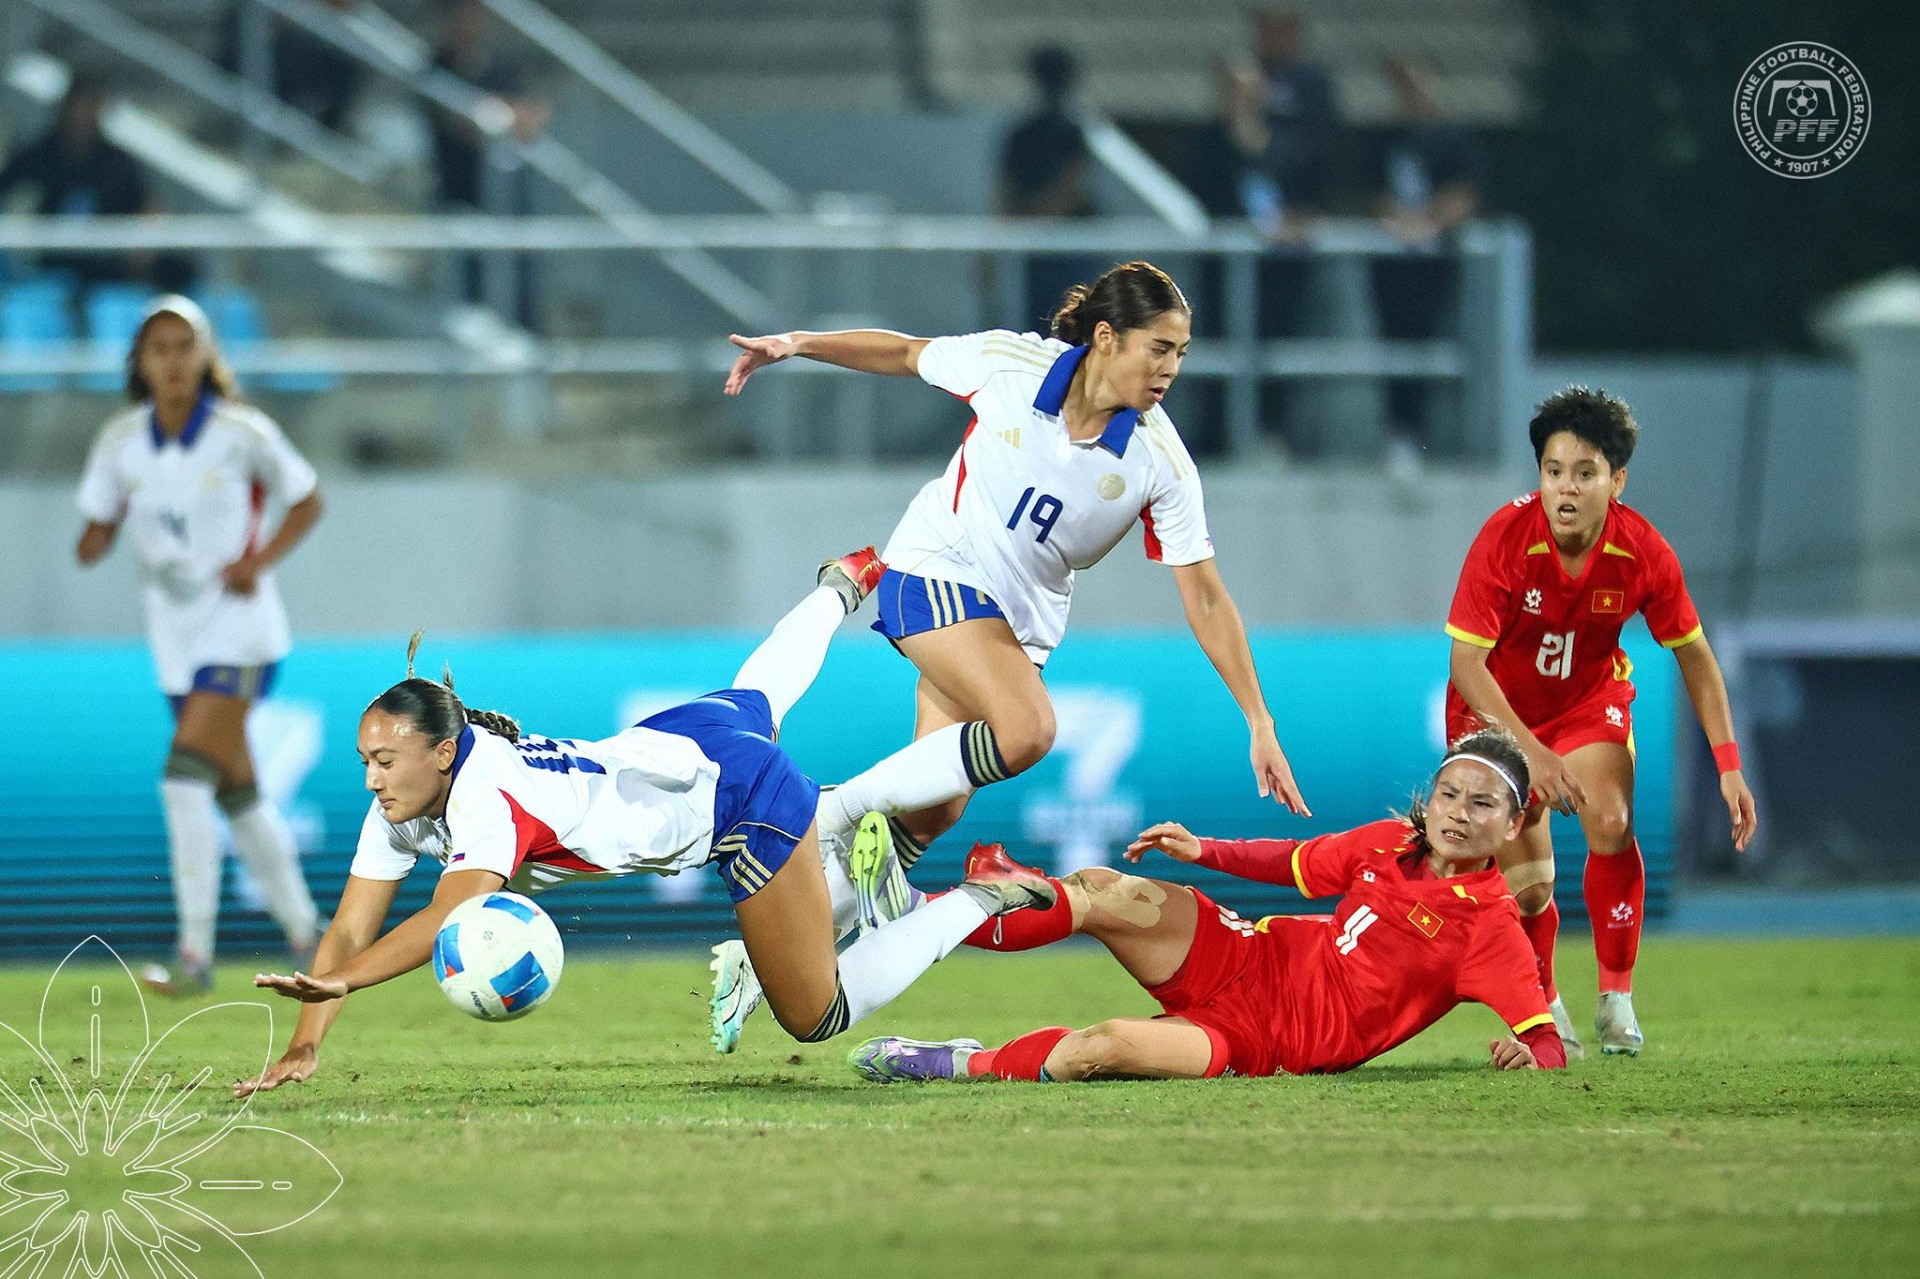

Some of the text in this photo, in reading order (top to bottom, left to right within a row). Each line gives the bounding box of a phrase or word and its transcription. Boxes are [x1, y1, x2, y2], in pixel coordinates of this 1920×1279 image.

[1006, 487, 1064, 544] 19
[1535, 631, 1576, 680] 21
[1335, 904, 1379, 956] 11
